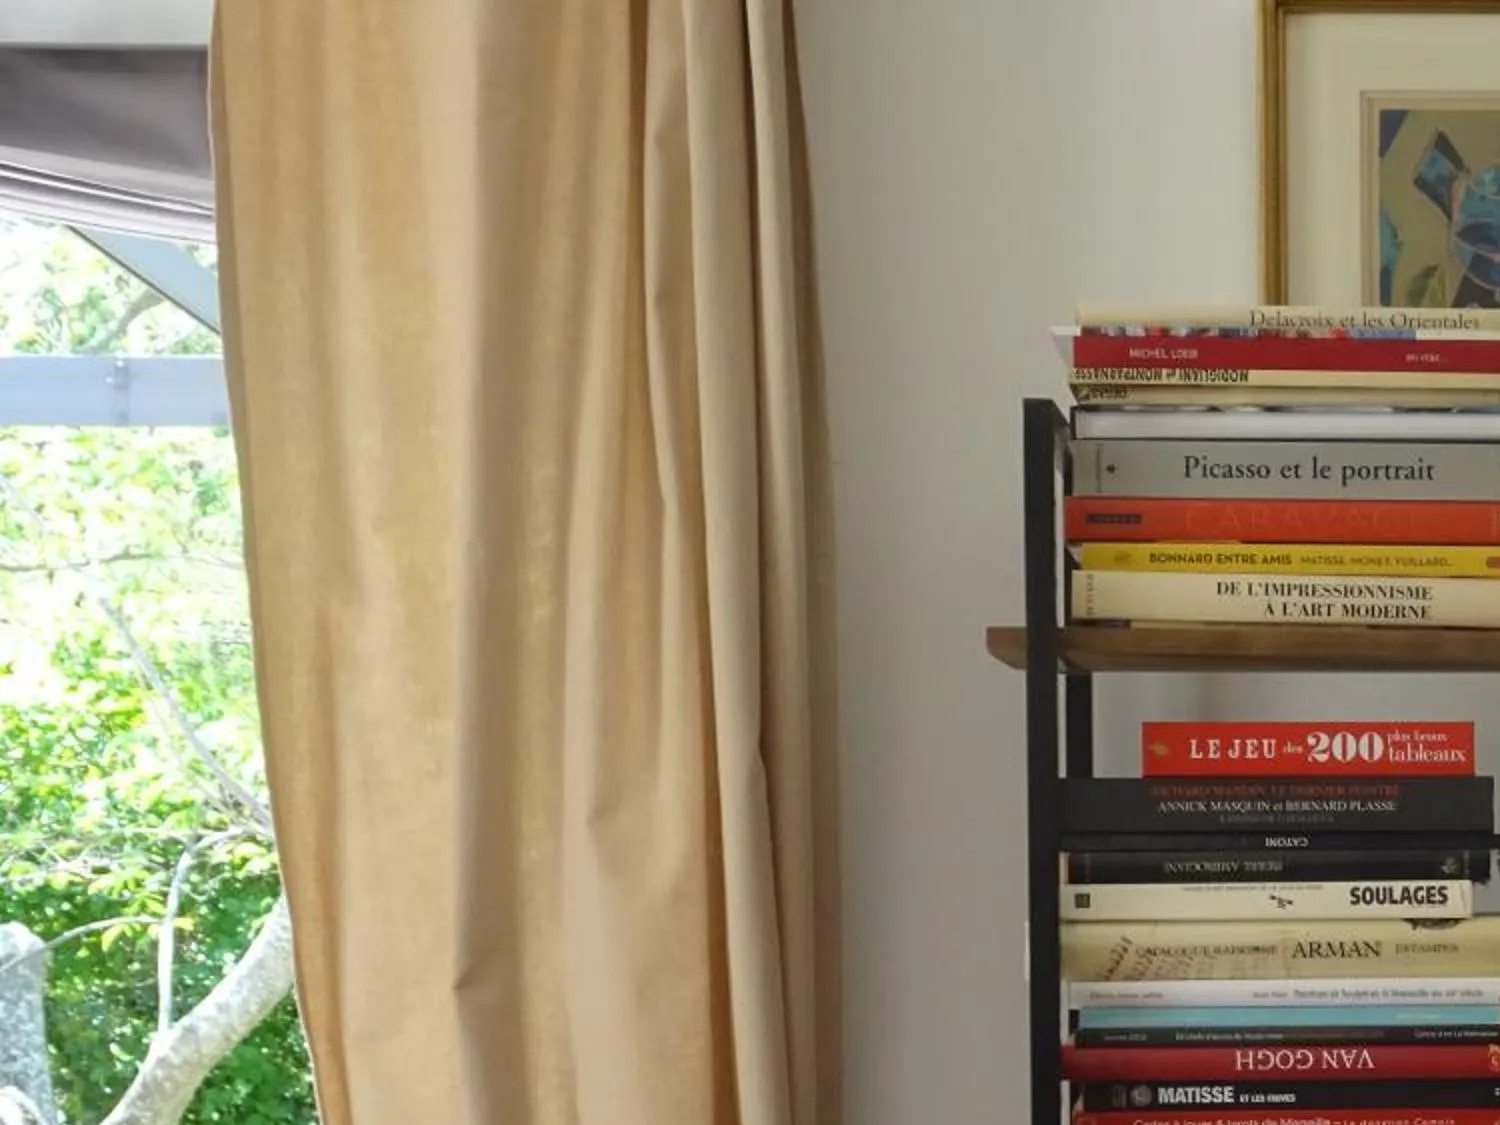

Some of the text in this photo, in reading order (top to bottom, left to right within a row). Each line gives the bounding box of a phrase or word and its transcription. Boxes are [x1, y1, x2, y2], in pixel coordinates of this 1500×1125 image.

[1250, 309, 1481, 330] Delacroix et les Orientales
[1183, 454, 1436, 488] Picasso et le portrait
[1149, 551, 1213, 565] BONNARD
[1217, 552, 1257, 565] ENTRE
[1261, 552, 1293, 565] AMIS
[1216, 580, 1433, 602] DE L'IMPRESSIONNISME
[1282, 601, 1336, 618] L'ART
[1341, 602, 1432, 620] MODERNE
[1190, 729, 1448, 764] LE JEU des 200 plus beaux
[1387, 742, 1467, 763] tableaux
[1158, 800, 1207, 813] ANNICK
[1285, 800, 1347, 813] BERNARD
[1349, 885, 1449, 905] SOULAGES
[1292, 941, 1382, 959] ARMAN
[1235, 1048, 1377, 1071] VAN GOGH
[1157, 1086, 1236, 1105] MATISSE
